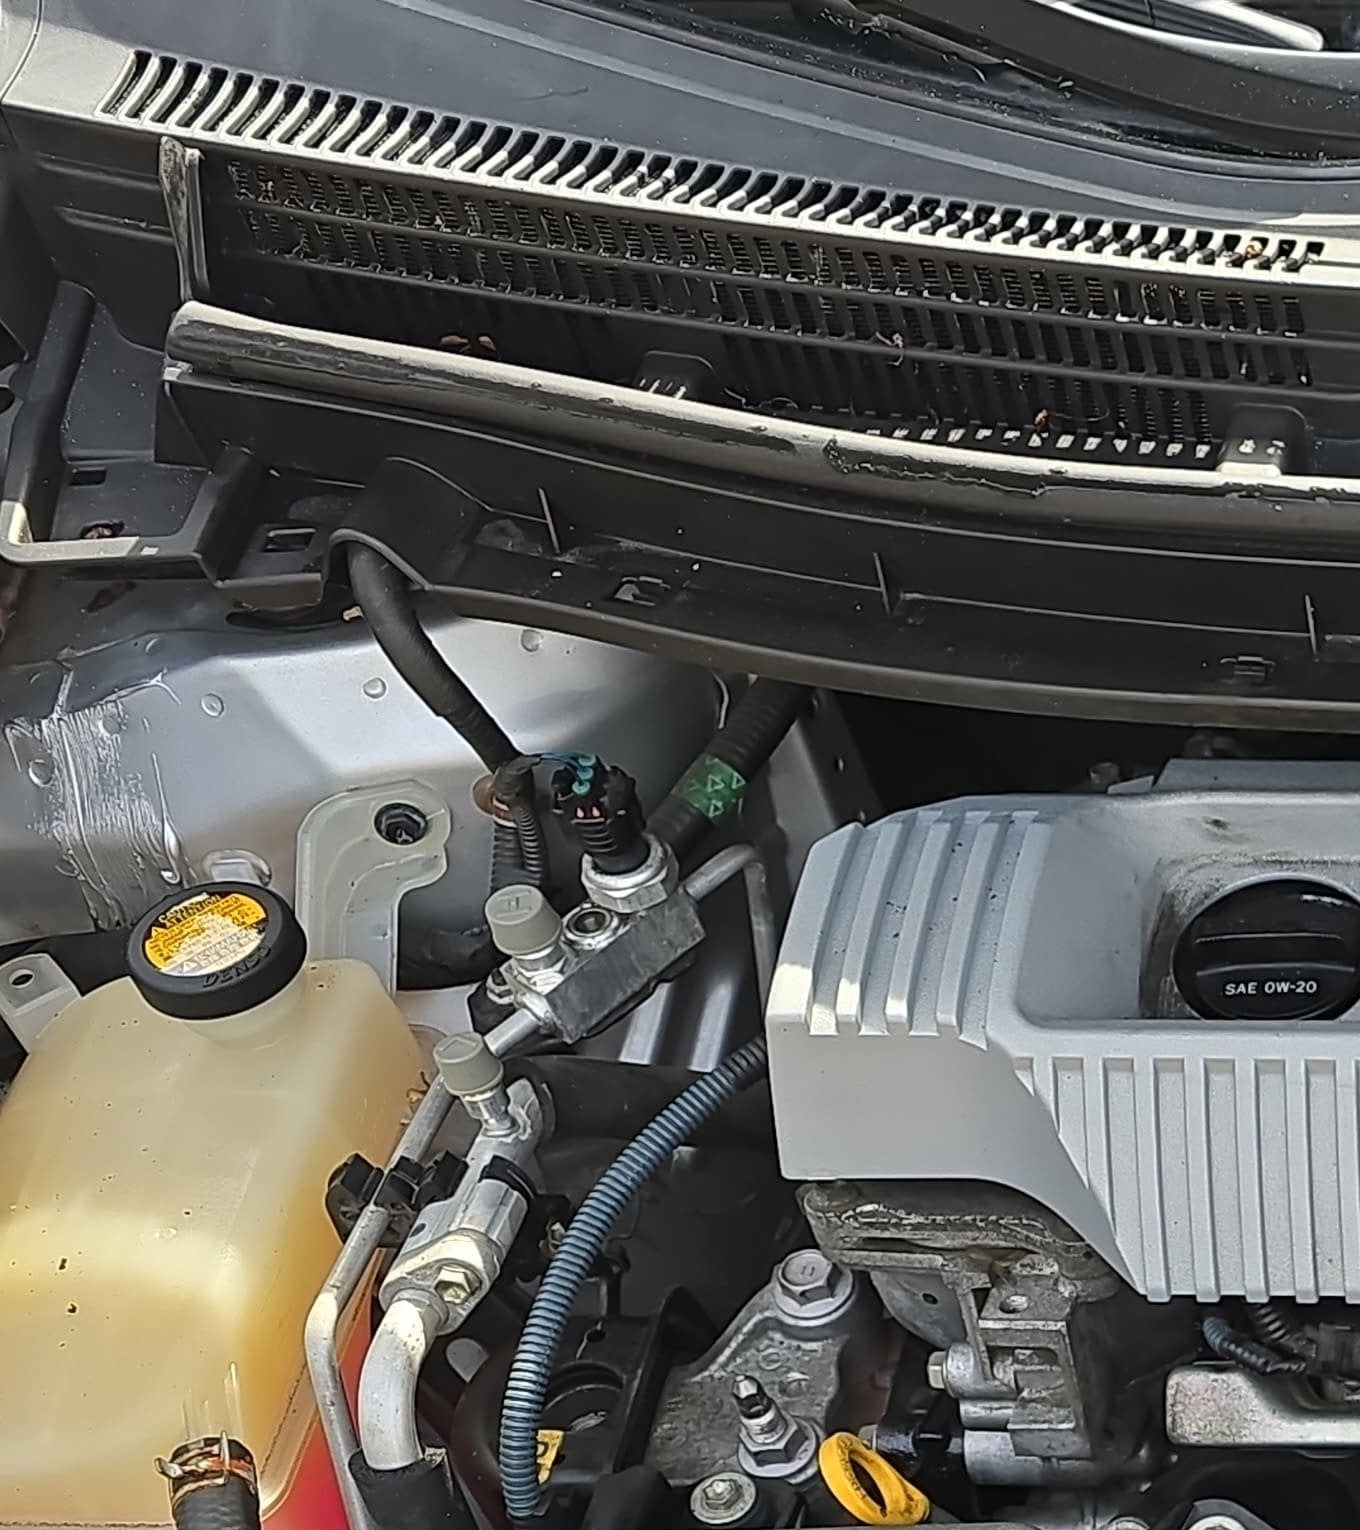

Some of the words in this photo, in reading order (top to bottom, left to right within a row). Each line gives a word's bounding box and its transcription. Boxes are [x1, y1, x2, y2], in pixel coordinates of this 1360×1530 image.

[203, 946, 271, 987] DENSO
[1225, 982, 1257, 995] SAE
[1264, 980, 1317, 994] 0W-20
